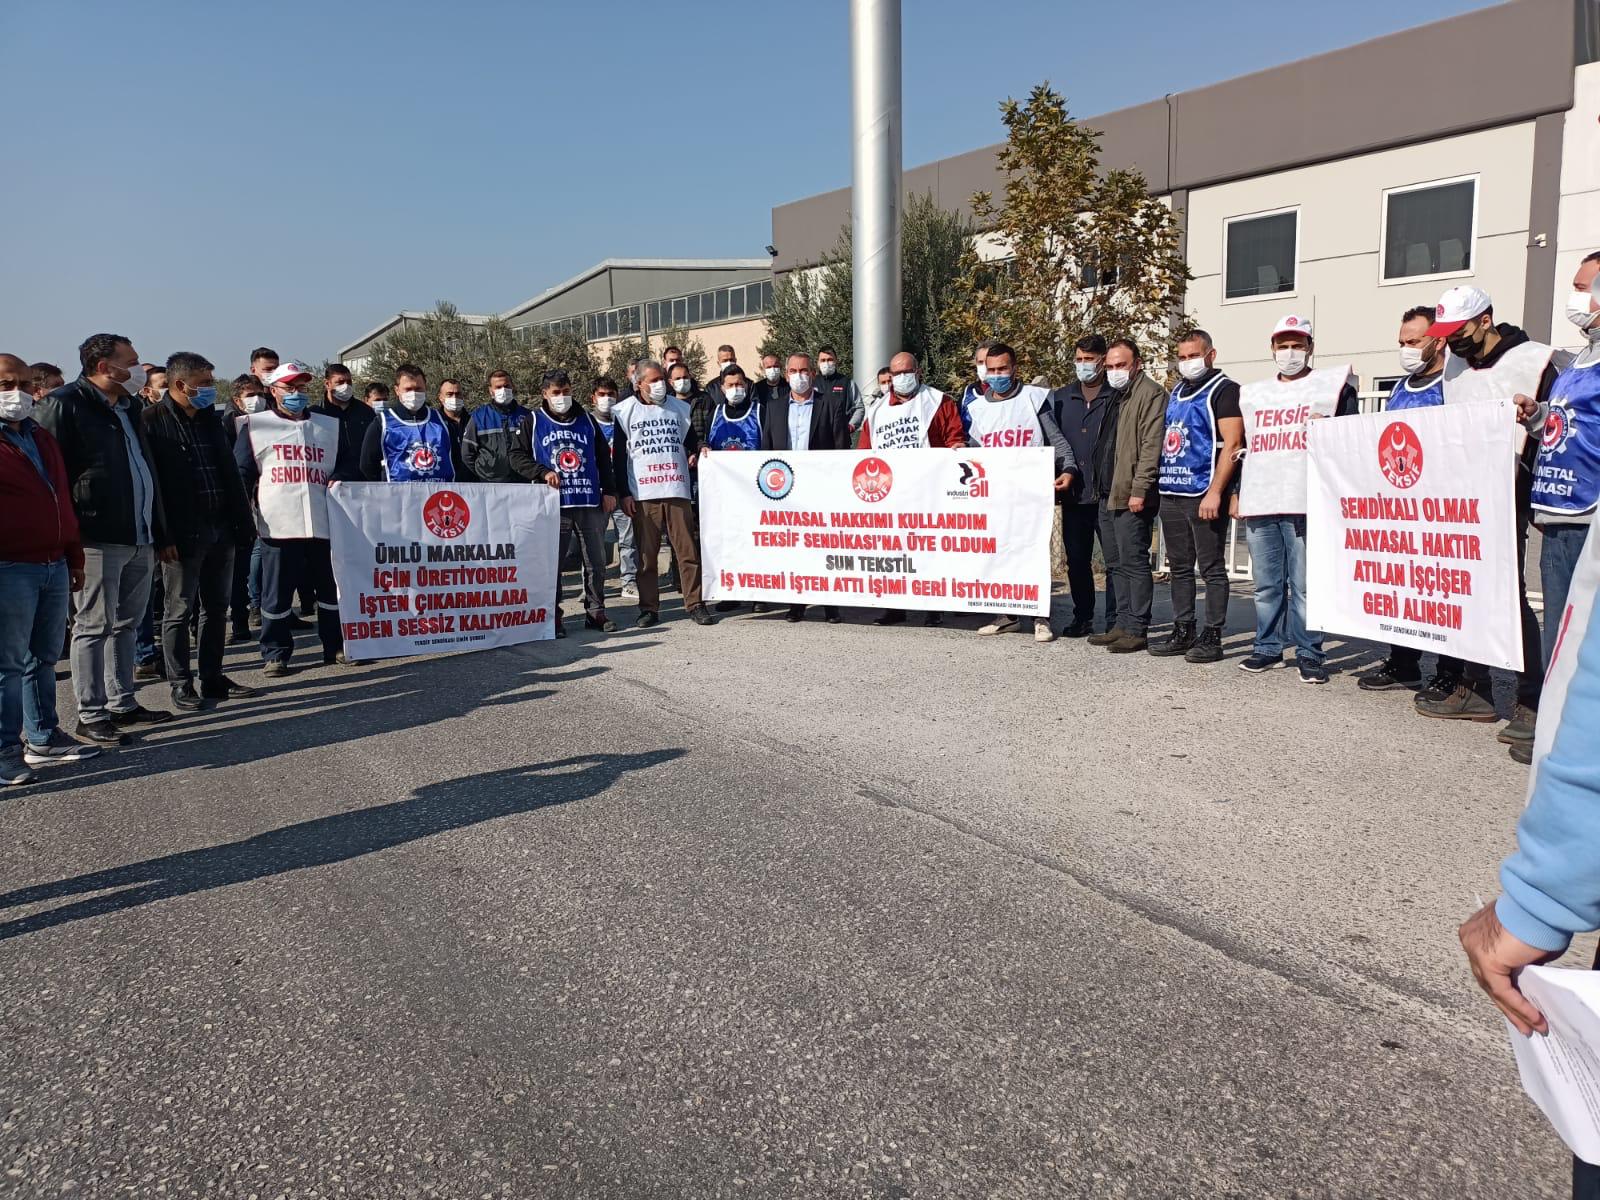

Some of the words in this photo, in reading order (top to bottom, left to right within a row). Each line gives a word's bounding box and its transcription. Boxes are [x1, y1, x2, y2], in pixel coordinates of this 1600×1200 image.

[1255, 403, 1310, 428] TEKSİF
[635, 436, 682, 448] ANAYASA
[642, 427, 678, 437] OLMAK
[884, 424, 919, 440] OLMAK
[981, 424, 1033, 447] EKSİF
[1251, 428, 1307, 453] ENDİKAS
[272, 444, 325, 463] TEKSİF
[642, 445, 680, 455] HAKTIR
[760, 510, 827, 527] ANAYASAL
[830, 512, 893, 529] HAKKIMI
[898, 512, 987, 530] KULLANDIM
[1340, 492, 1418, 521] SENDİKALI
[1423, 497, 1480, 524] OLMAK
[375, 542, 422, 564] ÜNLÜ
[427, 543, 516, 563] MARKALAR
[752, 529, 800, 547] TEKSİF
[803, 530, 902, 551] SENDİKASI'NA
[906, 532, 936, 551] ÜYE
[941, 536, 997, 553] OLDUM
[1344, 527, 1418, 555] ANAYASAL
[1422, 532, 1482, 561] HAKTIR
[825, 554, 854, 571] SUN
[858, 553, 917, 573] TEKSTİL
[373, 566, 411, 592] İÇİN
[416, 564, 517, 587] ÜRETİYORUZ
[720, 569, 735, 592] İŞ
[737, 571, 786, 590] VERENİ
[790, 571, 830, 594] İŞTEN
[833, 577, 864, 593] ATTI
[868, 574, 907, 598] İŞİMİ
[911, 577, 947, 597] GERİ
[951, 577, 1039, 601] İSTİYORUM
[1353, 560, 1405, 587] ATILAN
[1409, 559, 1472, 599] İŞÇİŞER
[359, 592, 409, 618] İŞTEN
[415, 588, 528, 615] ÇIKARMALARA
[1363, 590, 1399, 618] GERİ
[1403, 597, 1463, 630] ALINSIN
[397, 613, 455, 637] SESSİZ
[459, 607, 547, 632] KALIYORLAR
